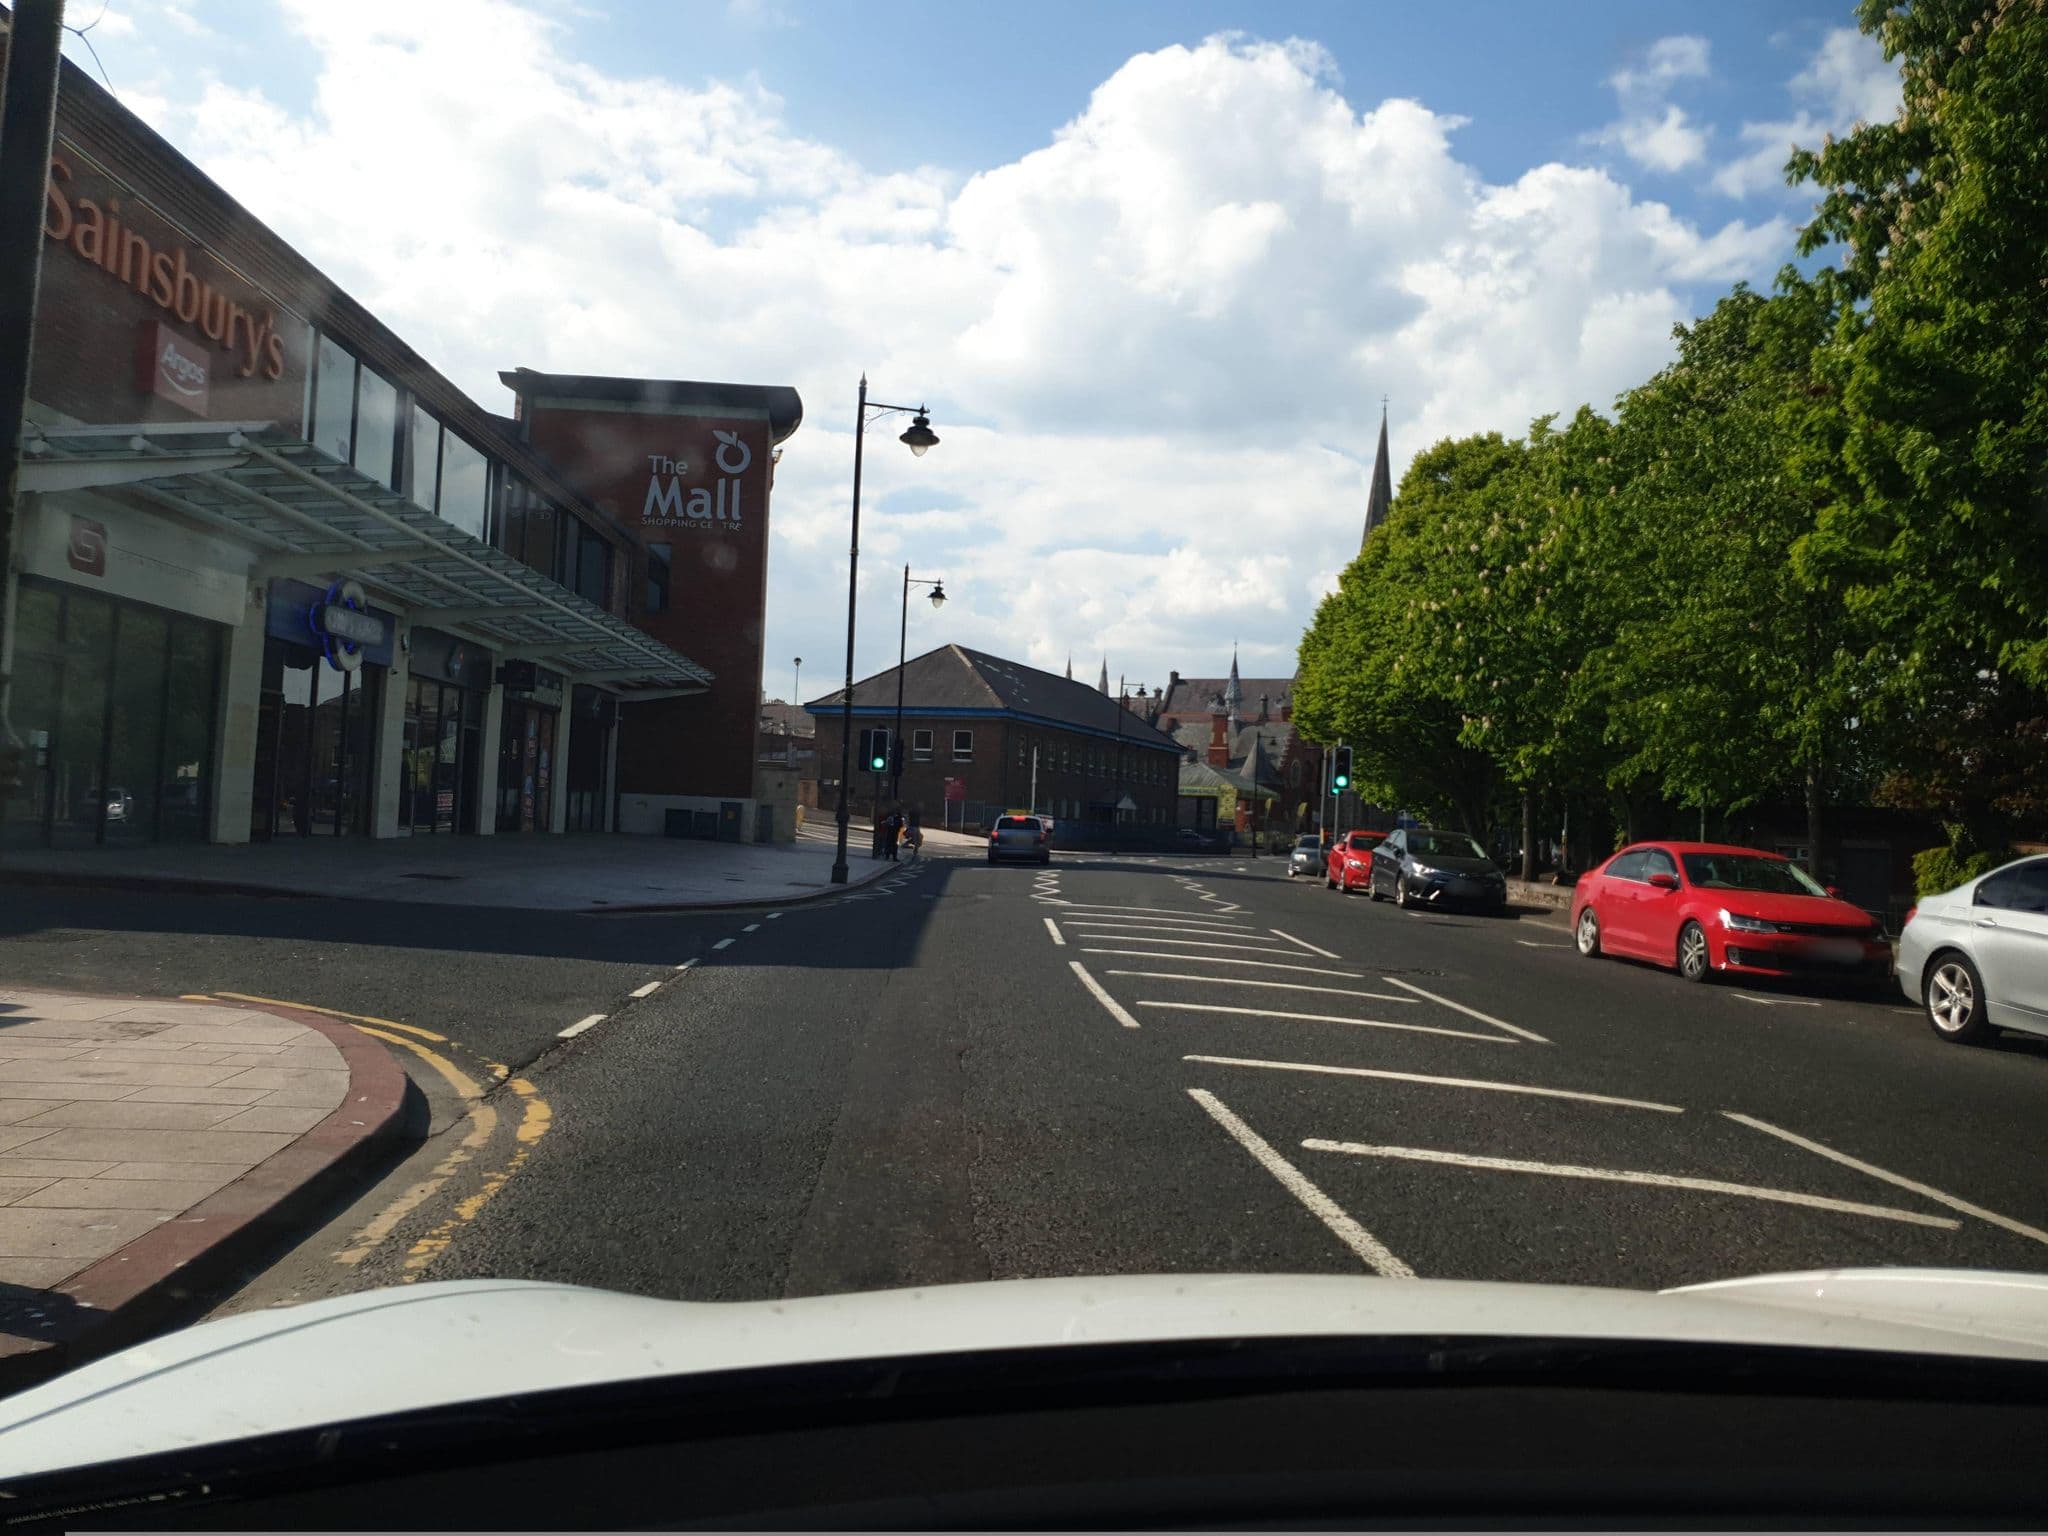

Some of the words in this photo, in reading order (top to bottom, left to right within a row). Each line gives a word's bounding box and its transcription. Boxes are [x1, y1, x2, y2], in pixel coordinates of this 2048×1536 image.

[45, 158, 285, 381] Sainsbury's
[648, 455, 688, 475] The
[643, 475, 742, 520] Mall
[641, 516, 697, 528] SHOPPING
